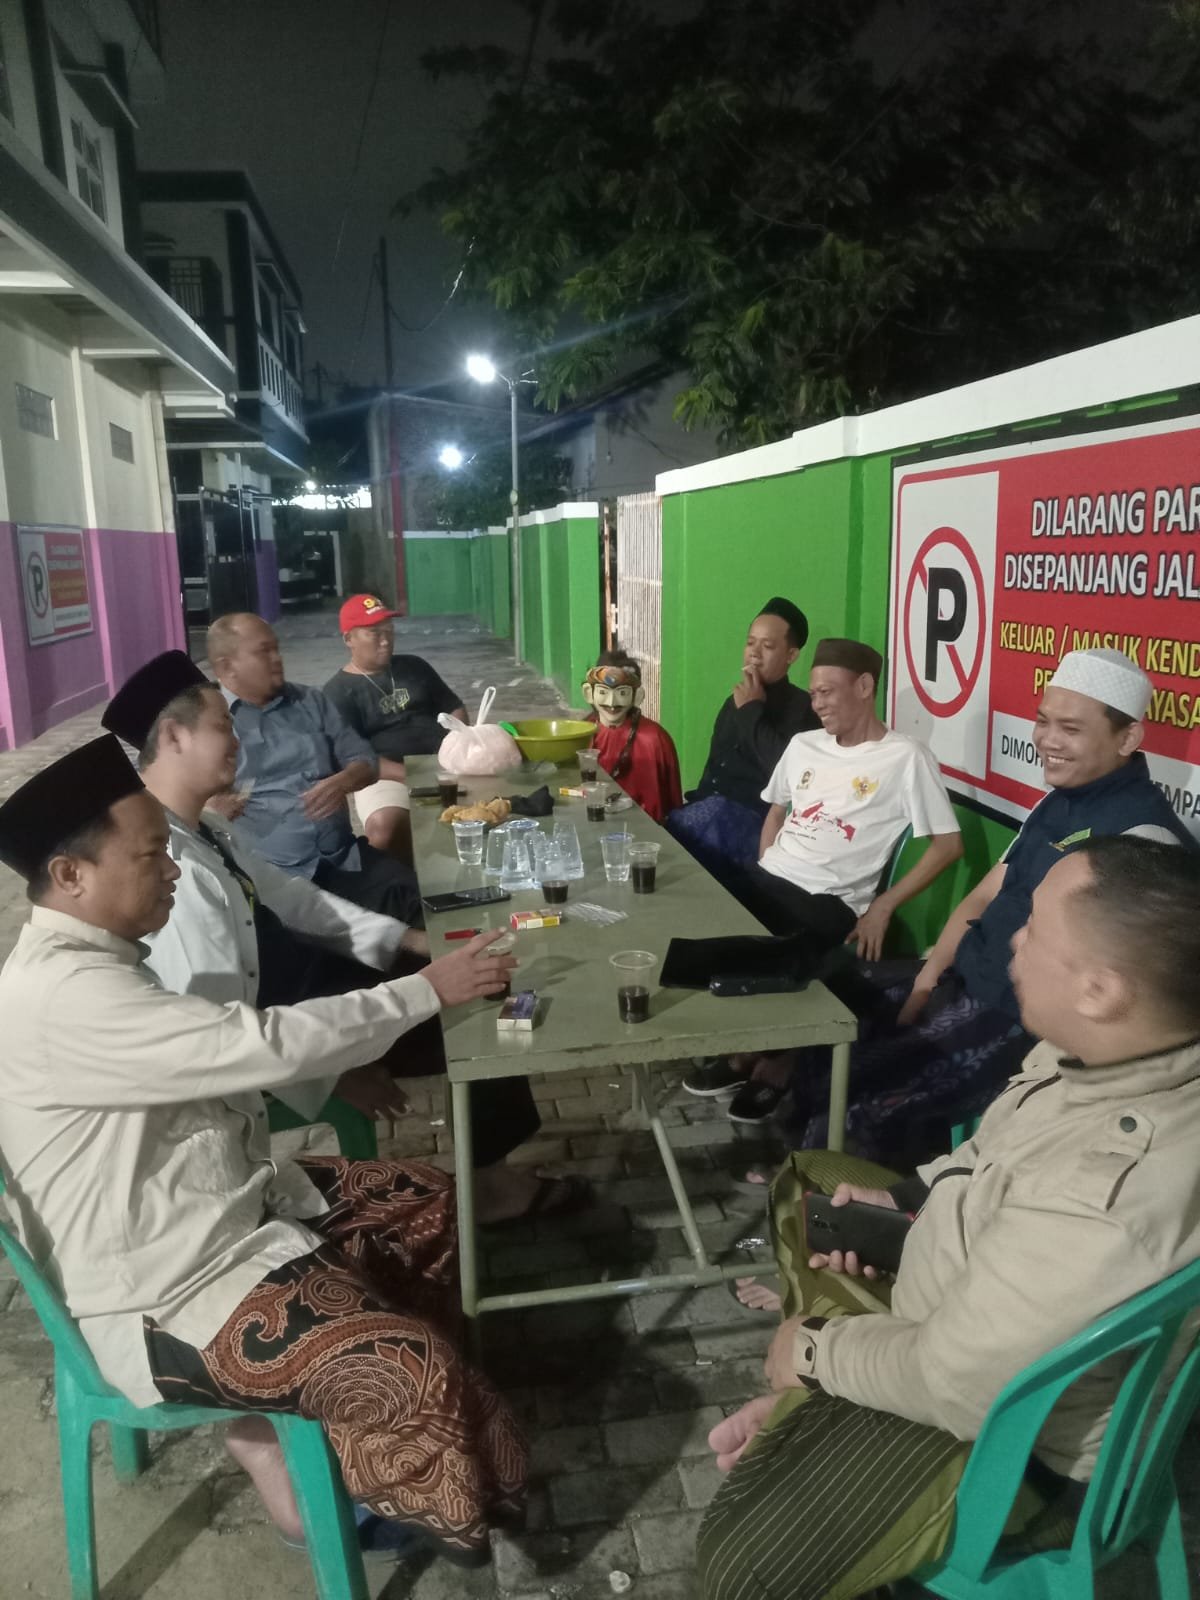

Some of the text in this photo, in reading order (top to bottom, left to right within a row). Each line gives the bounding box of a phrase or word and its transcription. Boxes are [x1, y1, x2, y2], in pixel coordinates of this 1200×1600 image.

[1031, 485, 1200, 537] DILARANG PAR
[1004, 553, 1148, 597] DISEPANJANG
[925, 567, 967, 682] P
[1000, 621, 1055, 656] KELUAR
